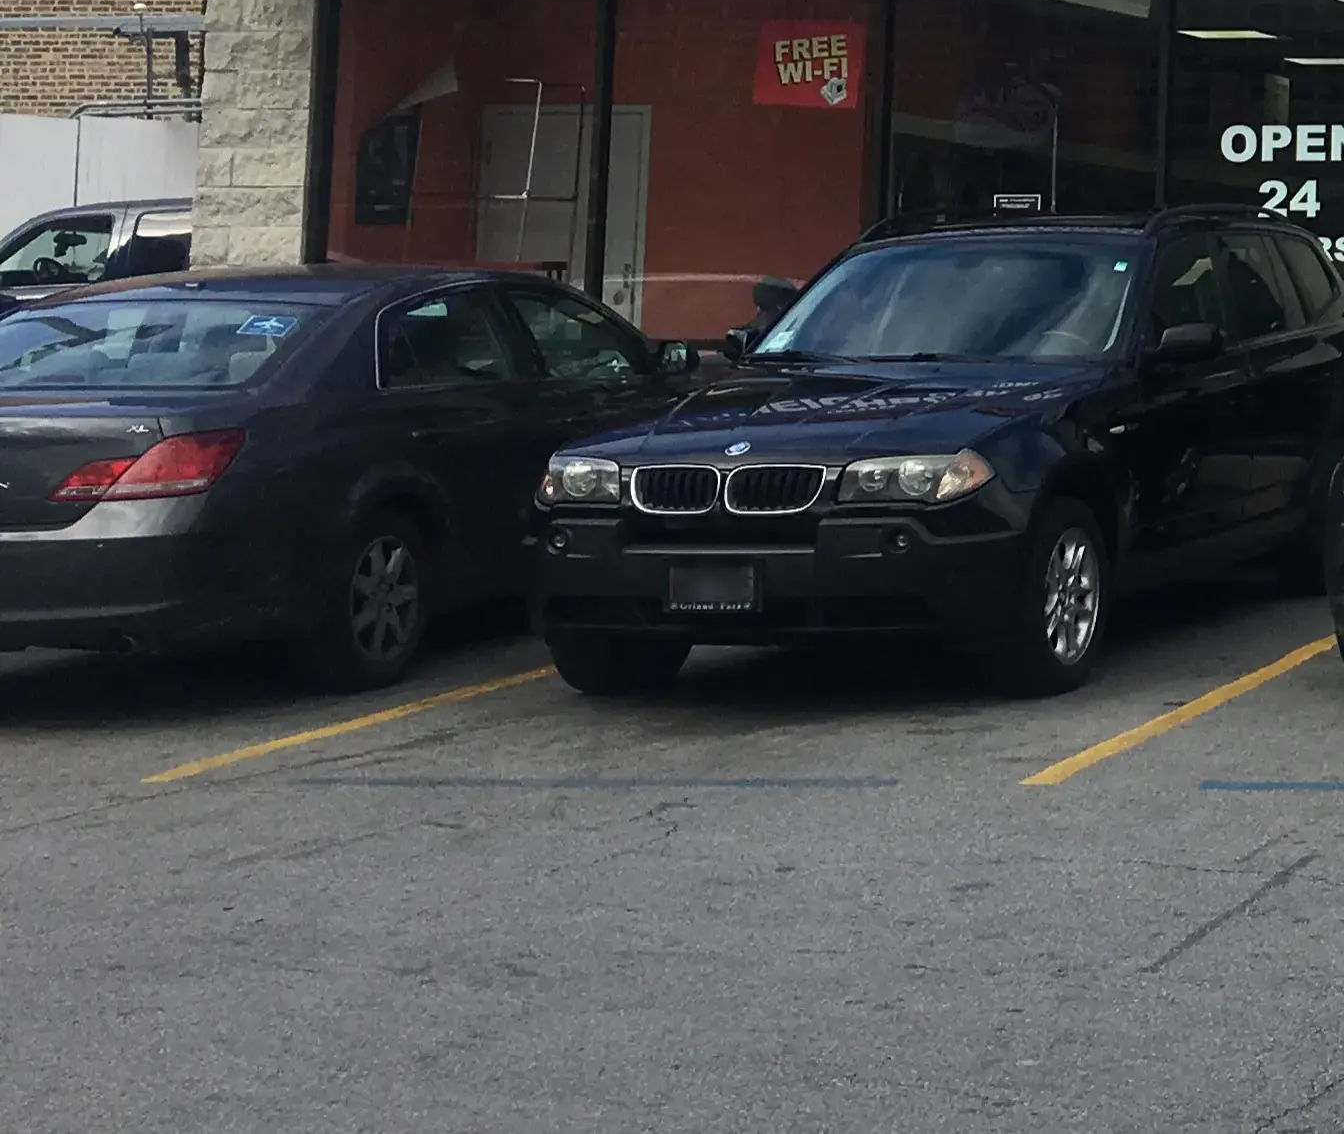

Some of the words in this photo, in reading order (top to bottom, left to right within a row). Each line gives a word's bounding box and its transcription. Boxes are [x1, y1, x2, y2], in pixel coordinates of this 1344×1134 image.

[775, 34, 847, 62] FREE
[777, 57, 848, 84] WI-FI
[1258, 179, 1321, 218] 24
